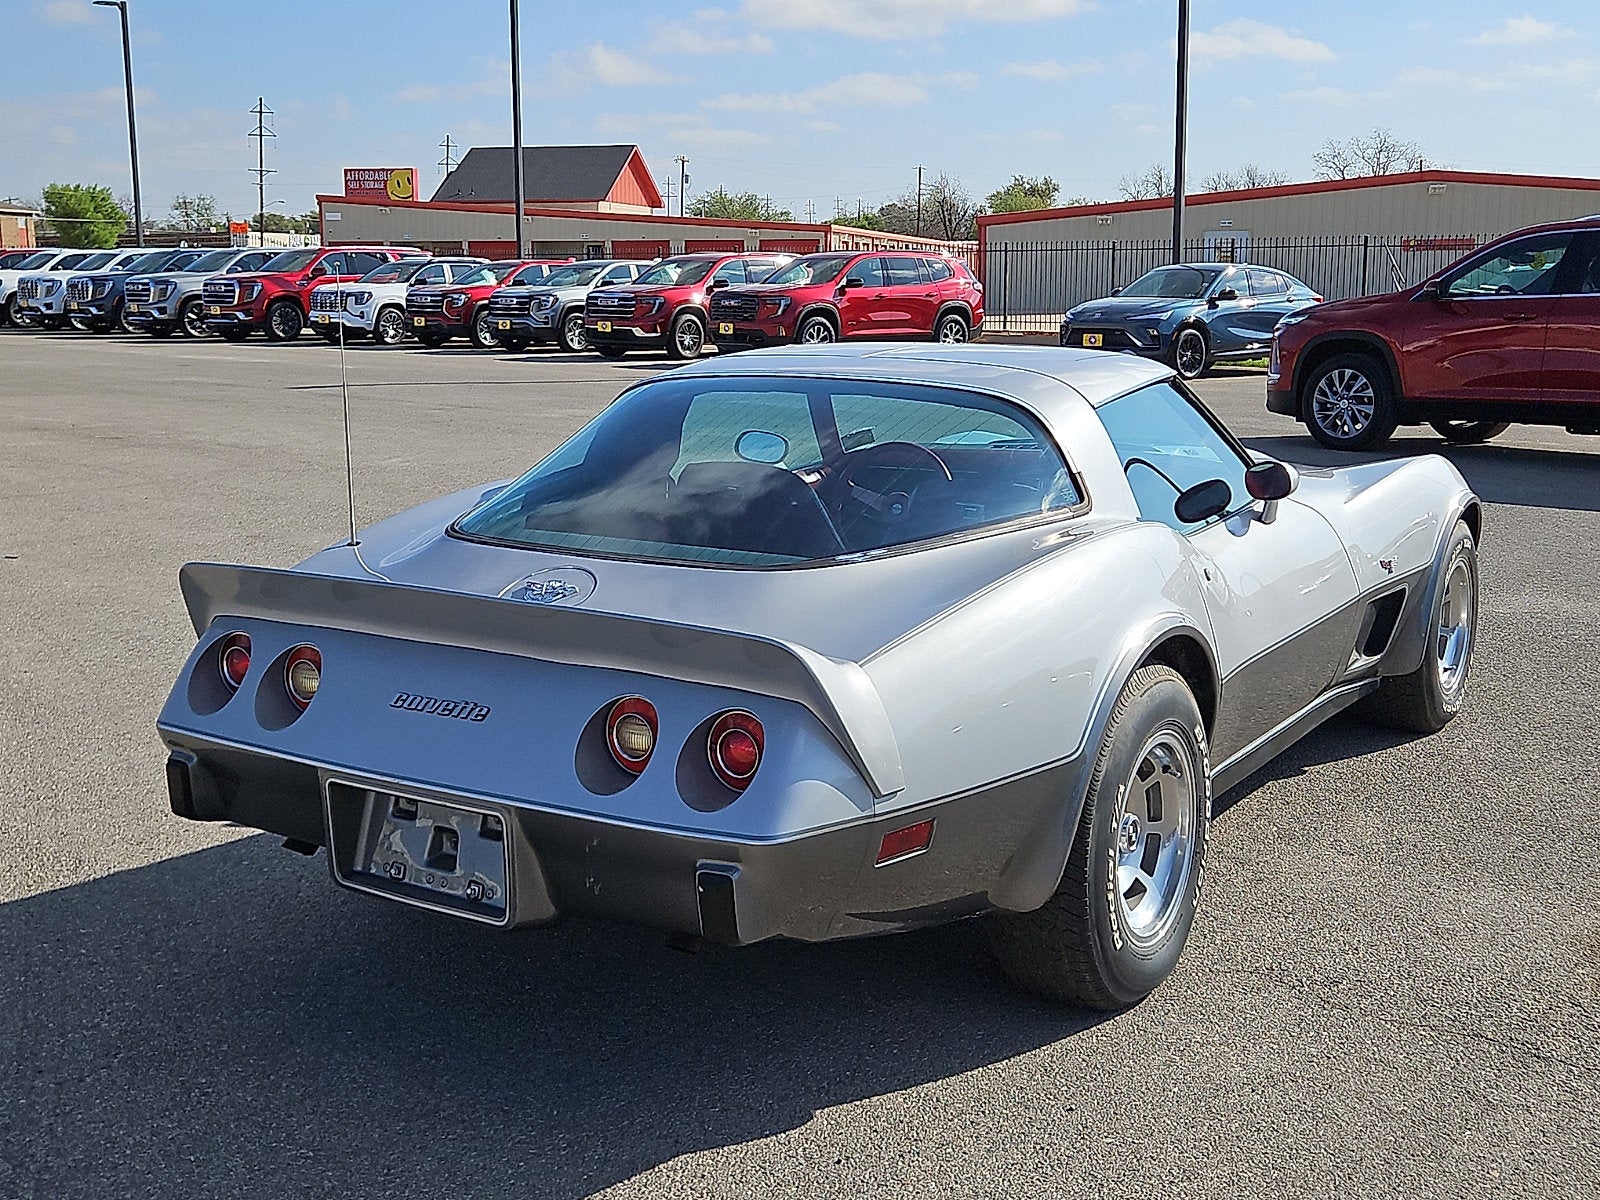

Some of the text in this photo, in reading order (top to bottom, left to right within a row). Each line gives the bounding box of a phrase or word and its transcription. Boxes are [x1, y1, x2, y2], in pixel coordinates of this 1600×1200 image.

[346, 170, 391, 181] AFFORDABLE
[347, 181, 385, 189] SELF STORAGE
[1106, 784, 1126, 951] Radial T/A
